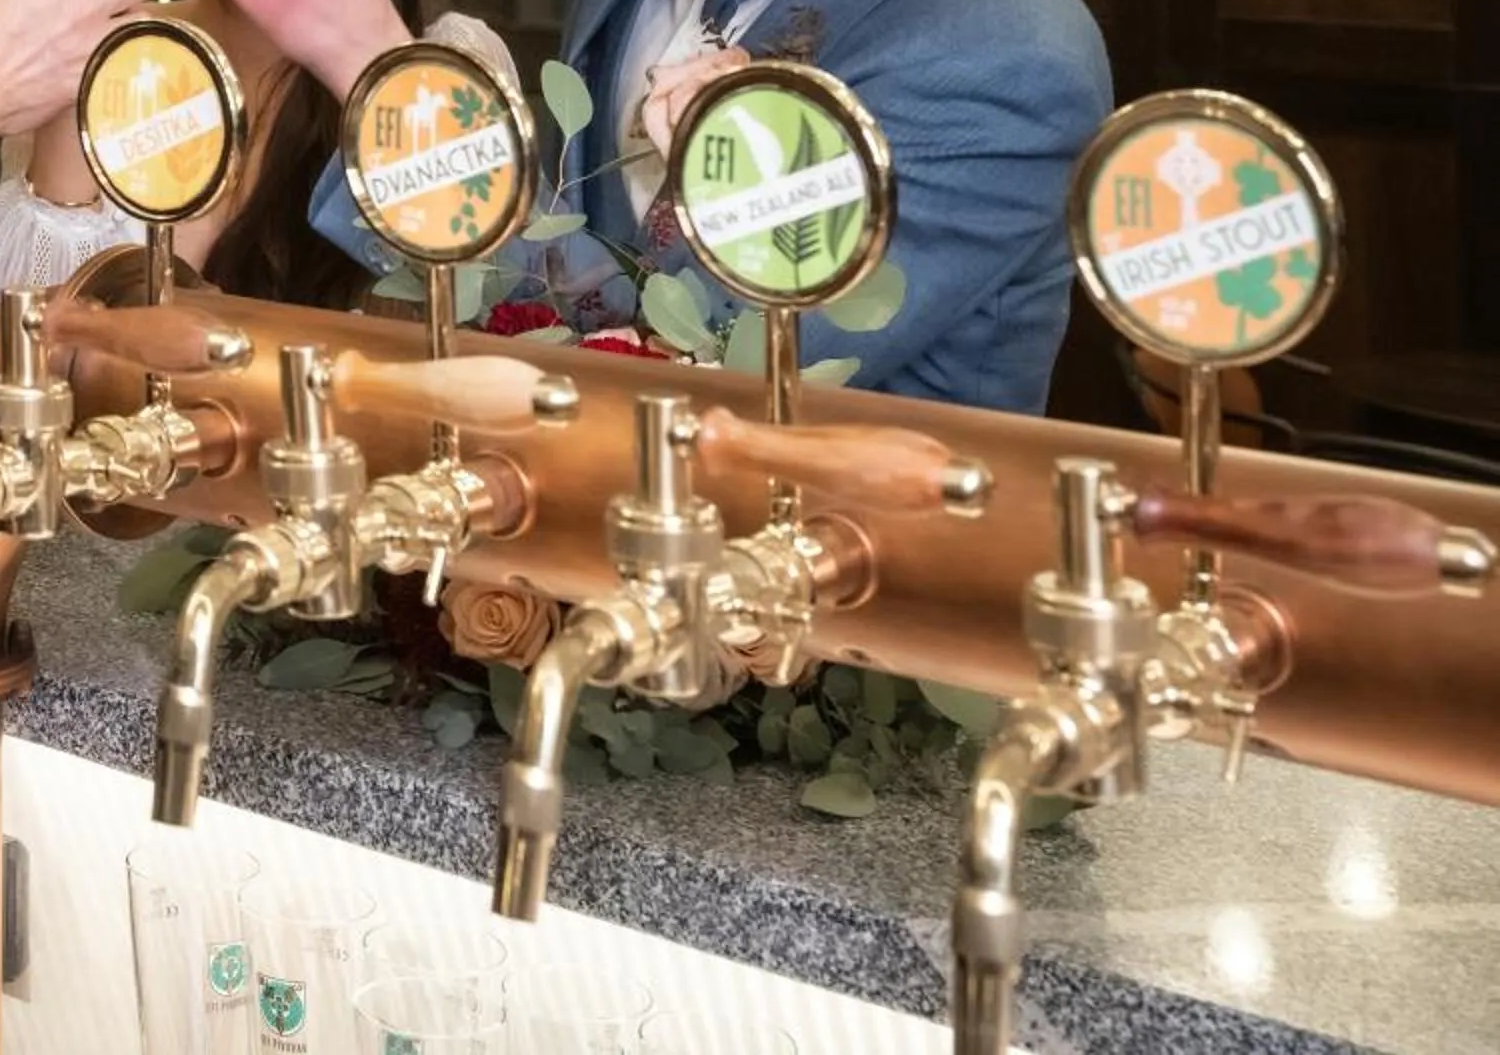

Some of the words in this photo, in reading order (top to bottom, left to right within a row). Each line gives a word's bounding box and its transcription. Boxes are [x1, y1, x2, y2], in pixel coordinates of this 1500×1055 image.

[376, 105, 402, 151] EFI
[704, 135, 735, 183] EFI
[699, 209, 740, 231] NEW
[747, 180, 822, 221] ZEALAND
[1114, 175, 1151, 228] EFI
[1116, 242, 1193, 290] IRISH
[1200, 202, 1302, 262] STOUT
